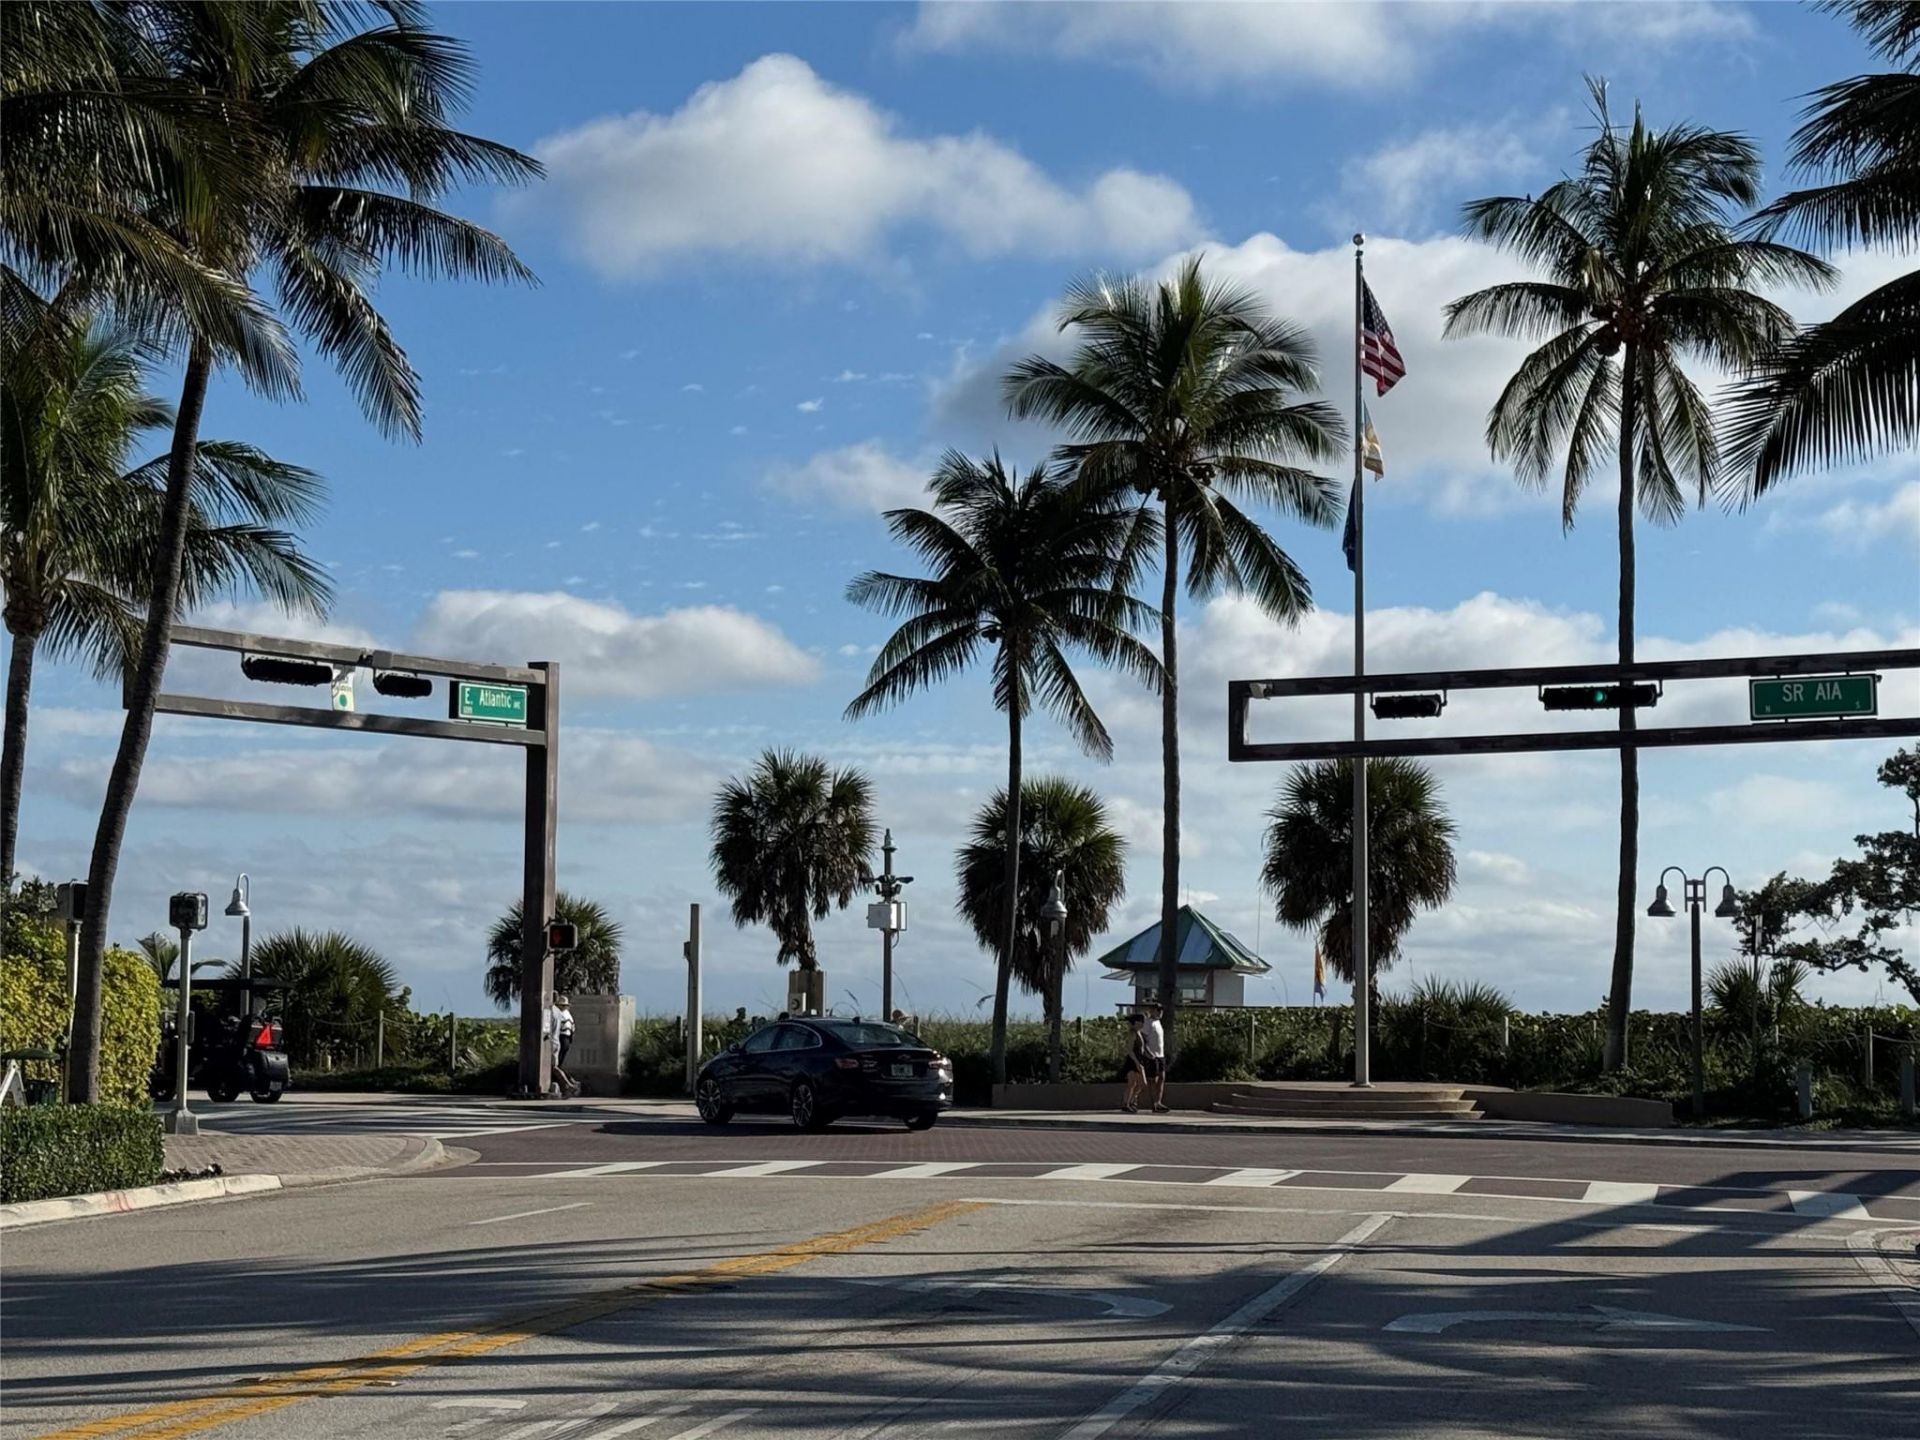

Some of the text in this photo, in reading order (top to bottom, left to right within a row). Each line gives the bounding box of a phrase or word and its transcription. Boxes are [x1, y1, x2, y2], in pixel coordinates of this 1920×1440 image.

[479, 689, 512, 708] Atlantic
[1782, 682, 1842, 702] SR A1A
